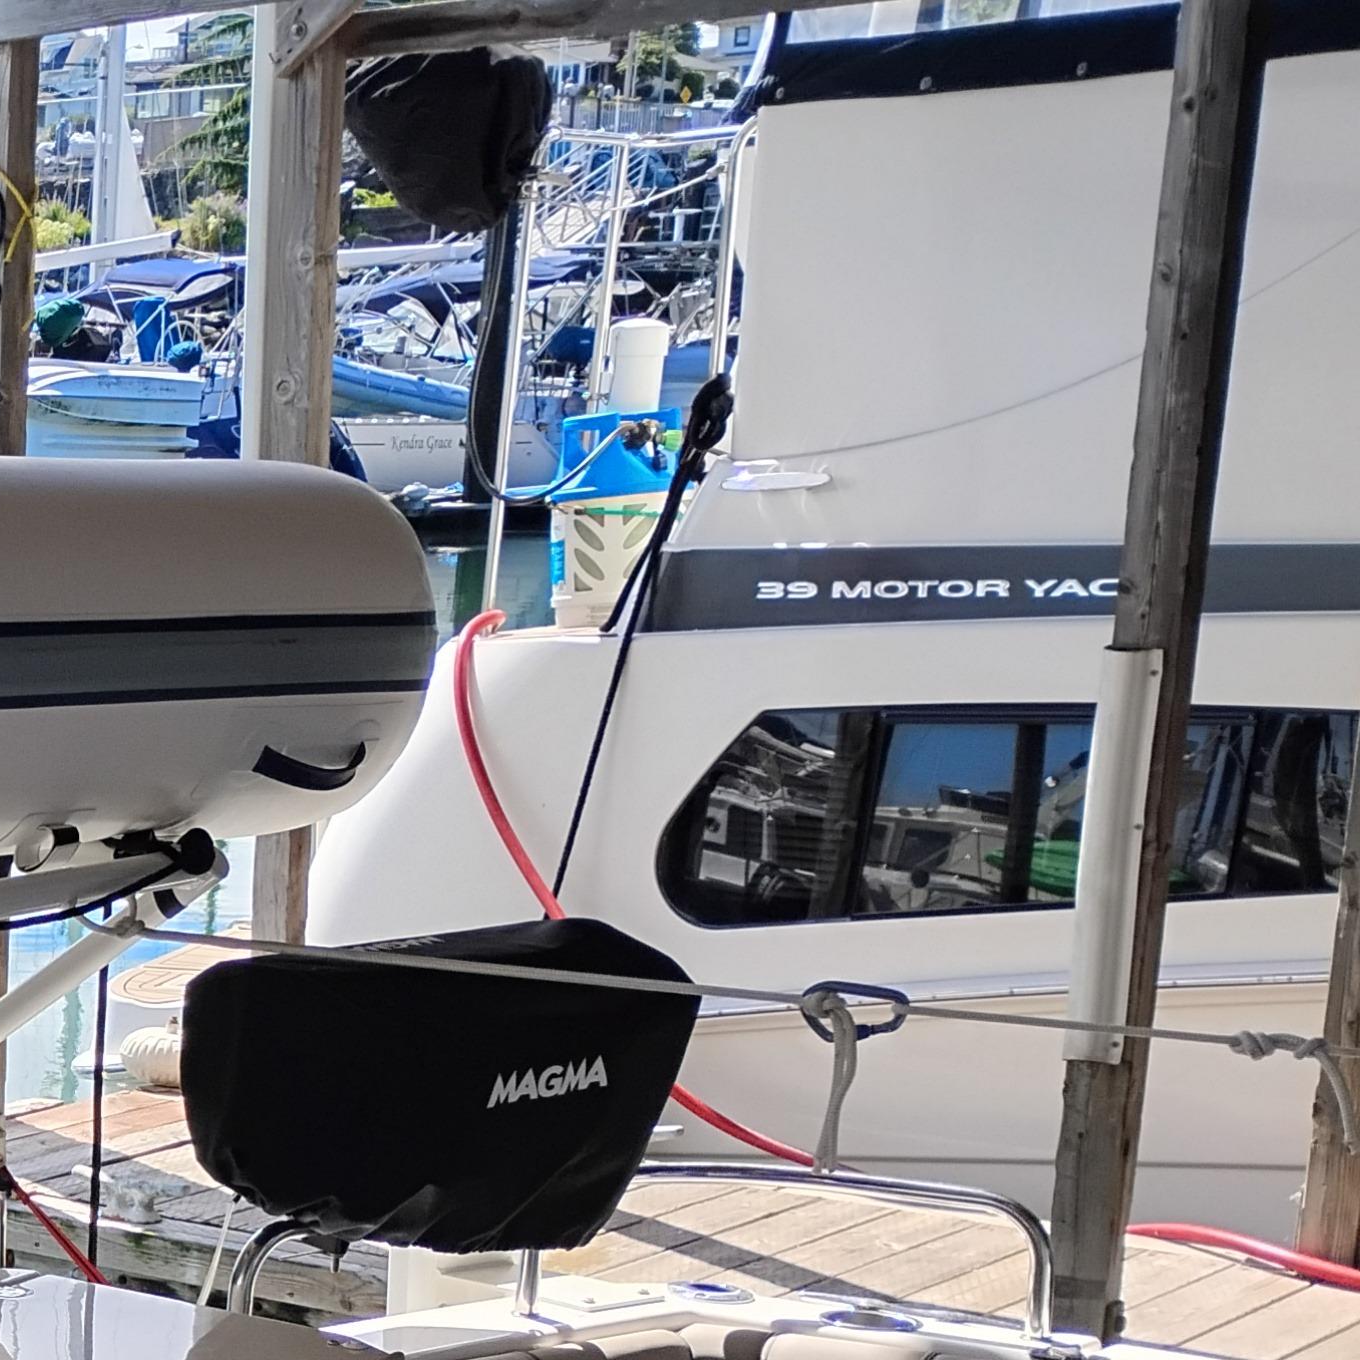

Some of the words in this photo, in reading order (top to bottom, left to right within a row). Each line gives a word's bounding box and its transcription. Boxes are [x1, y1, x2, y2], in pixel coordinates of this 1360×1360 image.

[391, 433, 424, 453] Kendra
[426, 435, 453, 454] Grace
[755, 580, 818, 600] 39
[831, 579, 1010, 600] MOTOR
[486, 1054, 609, 1110] MAGMA
